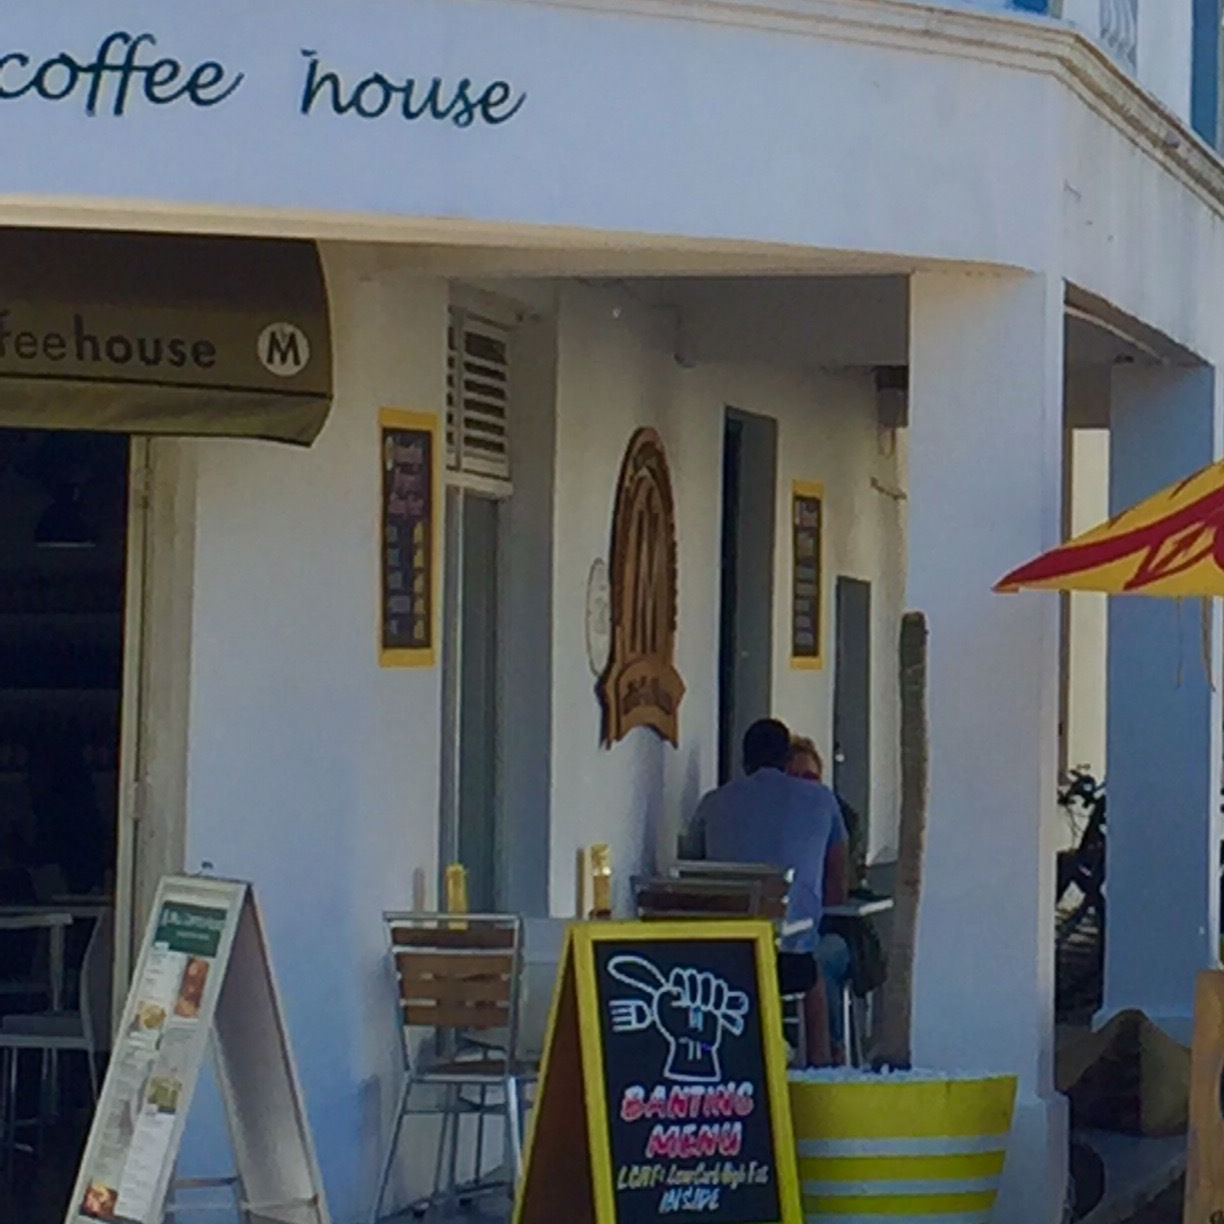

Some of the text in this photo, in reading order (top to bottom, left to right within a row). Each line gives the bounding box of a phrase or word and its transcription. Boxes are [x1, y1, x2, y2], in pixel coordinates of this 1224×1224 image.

[0, 31, 527, 128] coffee house
[620, 1081, 754, 1122] BANTING
[645, 1121, 743, 1158] MENU
